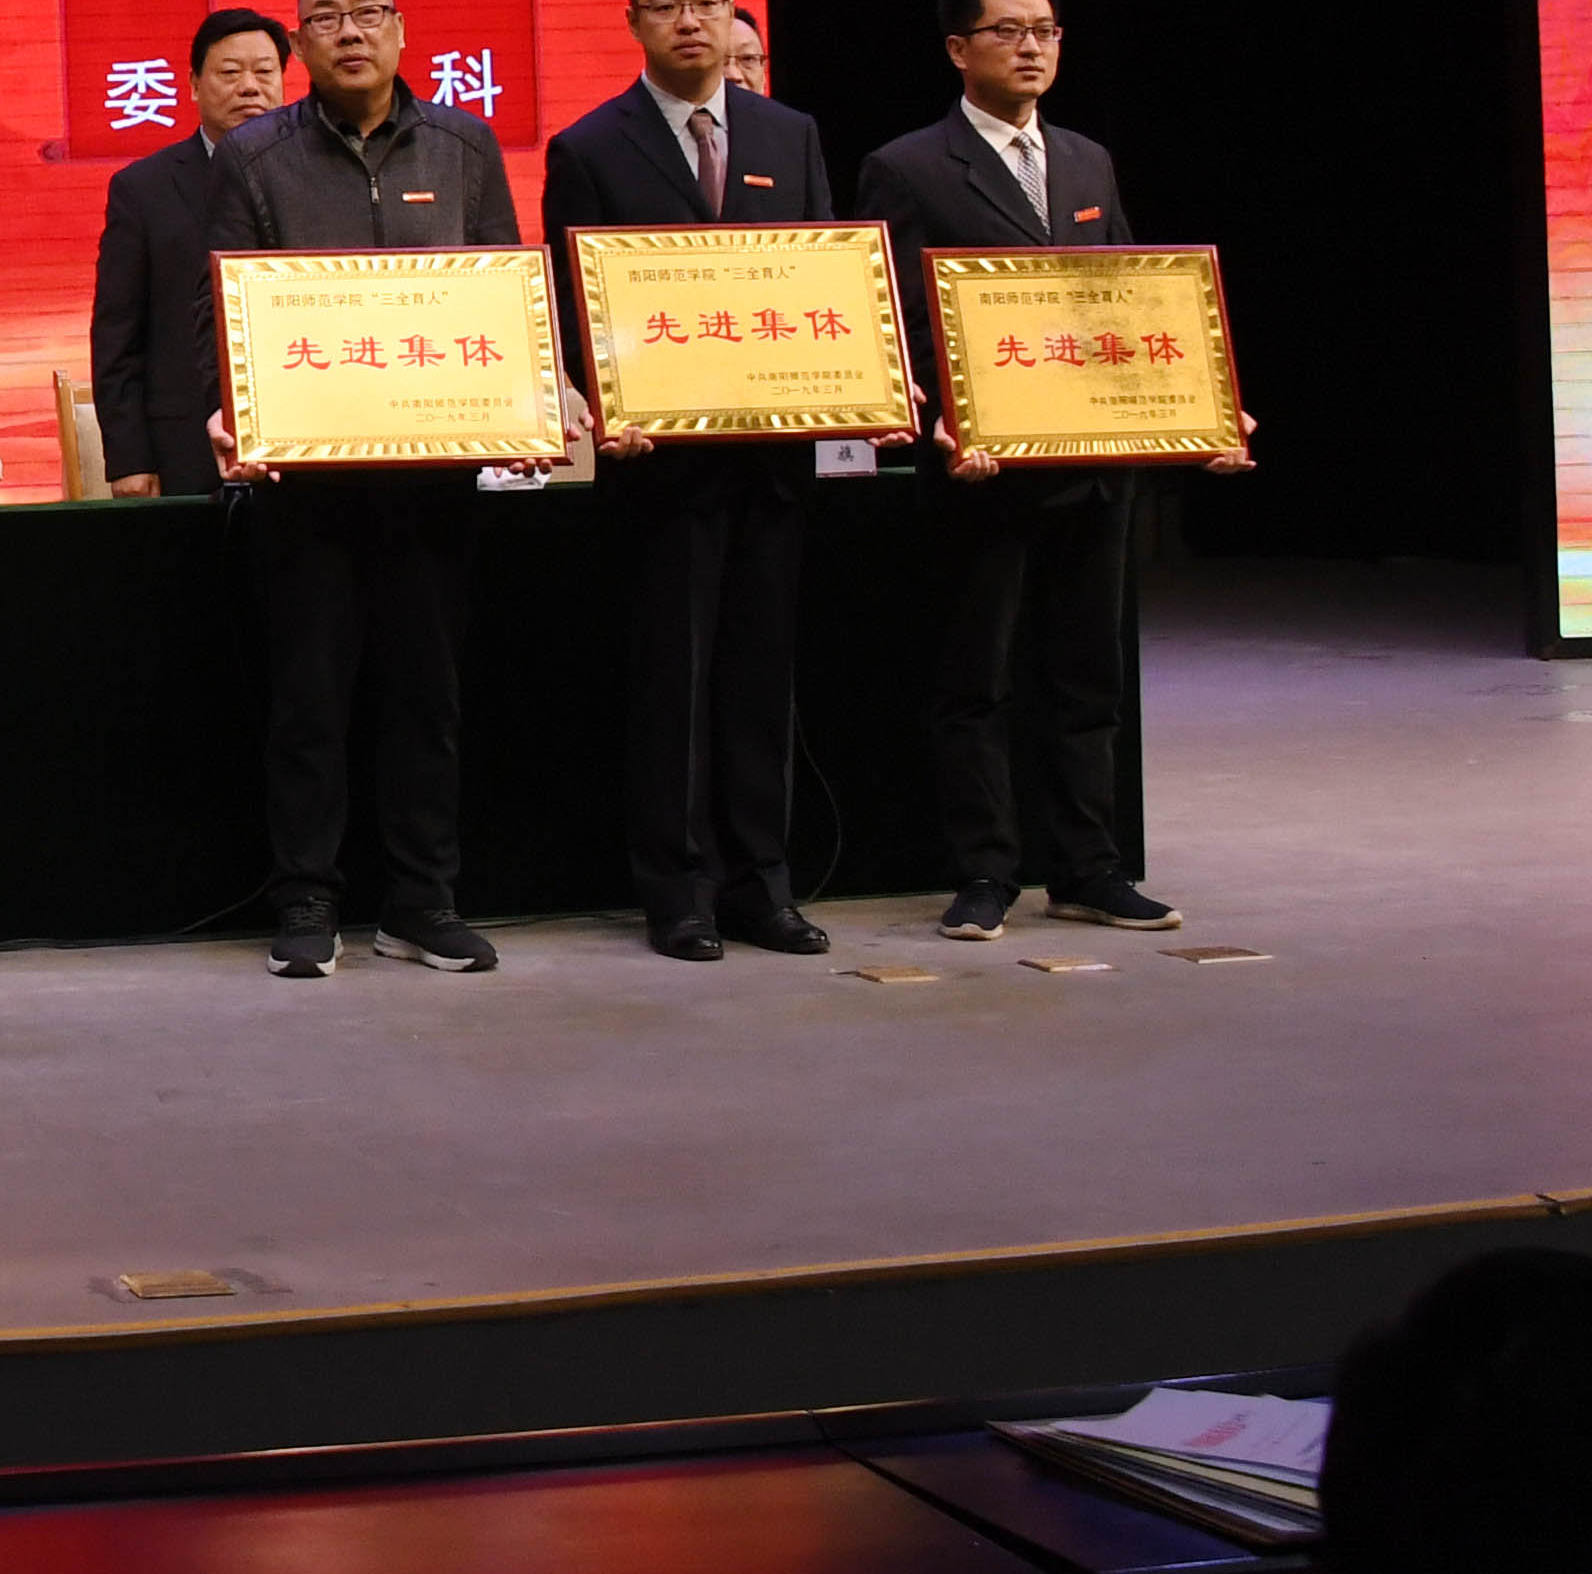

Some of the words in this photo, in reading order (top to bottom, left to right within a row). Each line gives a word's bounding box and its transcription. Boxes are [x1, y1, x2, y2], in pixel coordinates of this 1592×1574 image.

[628, 266, 796, 283] 南阳师范学院“三全育人”
[272, 291, 450, 308] 南阳师范学院“三全育人”
[979, 289, 1133, 306] 南阳师范学院“三全育人”
[643, 307, 852, 344] 先进集体
[282, 334, 504, 370] 先进集体
[993, 331, 1184, 368] 先进集体
